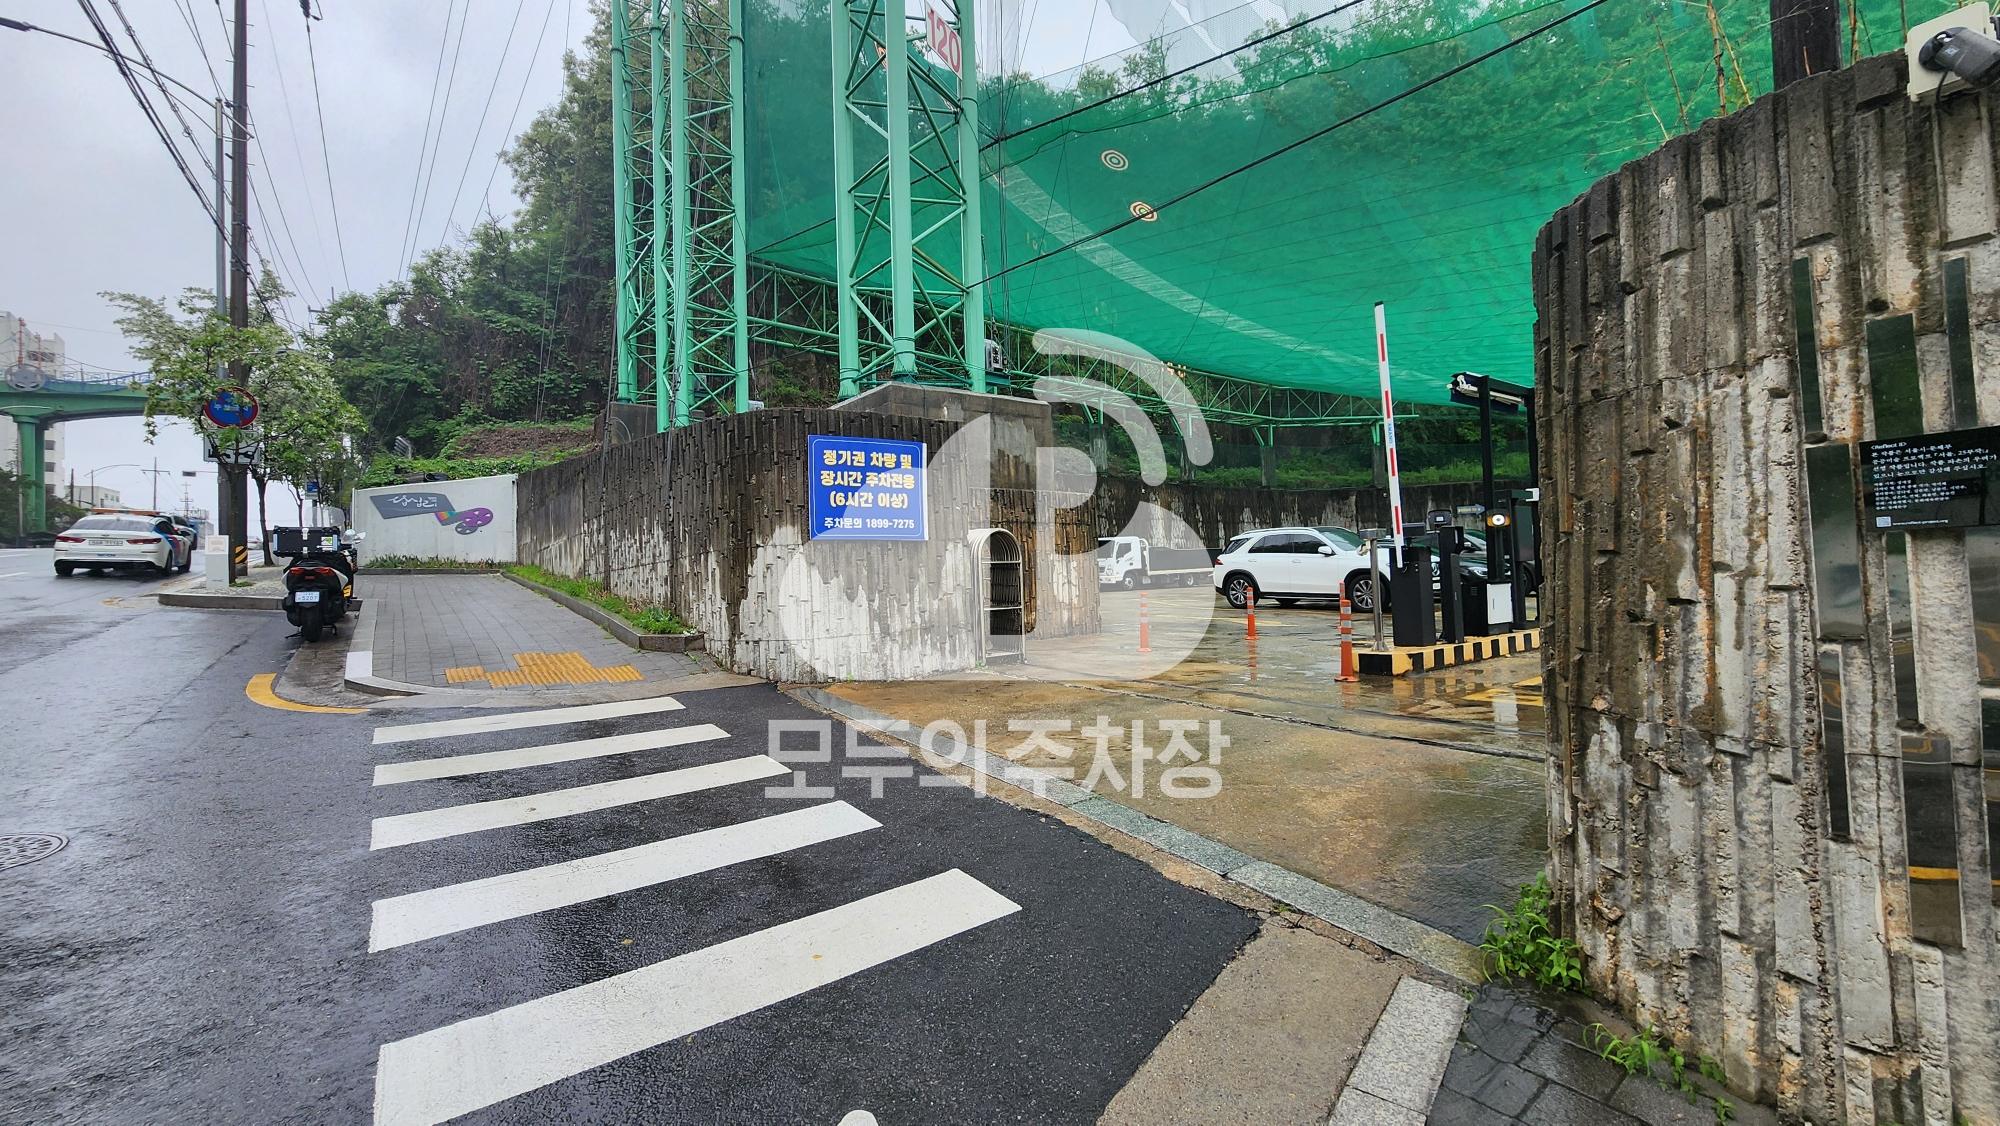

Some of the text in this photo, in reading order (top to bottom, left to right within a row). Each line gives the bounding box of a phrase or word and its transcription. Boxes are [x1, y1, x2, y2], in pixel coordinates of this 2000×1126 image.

[927, 8, 961, 73] 120
[823, 449, 912, 469] 정기권 차량 및
[820, 471, 915, 490] 장시간 주차전용
[829, 490, 909, 509] (6시간 이상)
[824, 517, 915, 529] 주차문의 1899-7275
